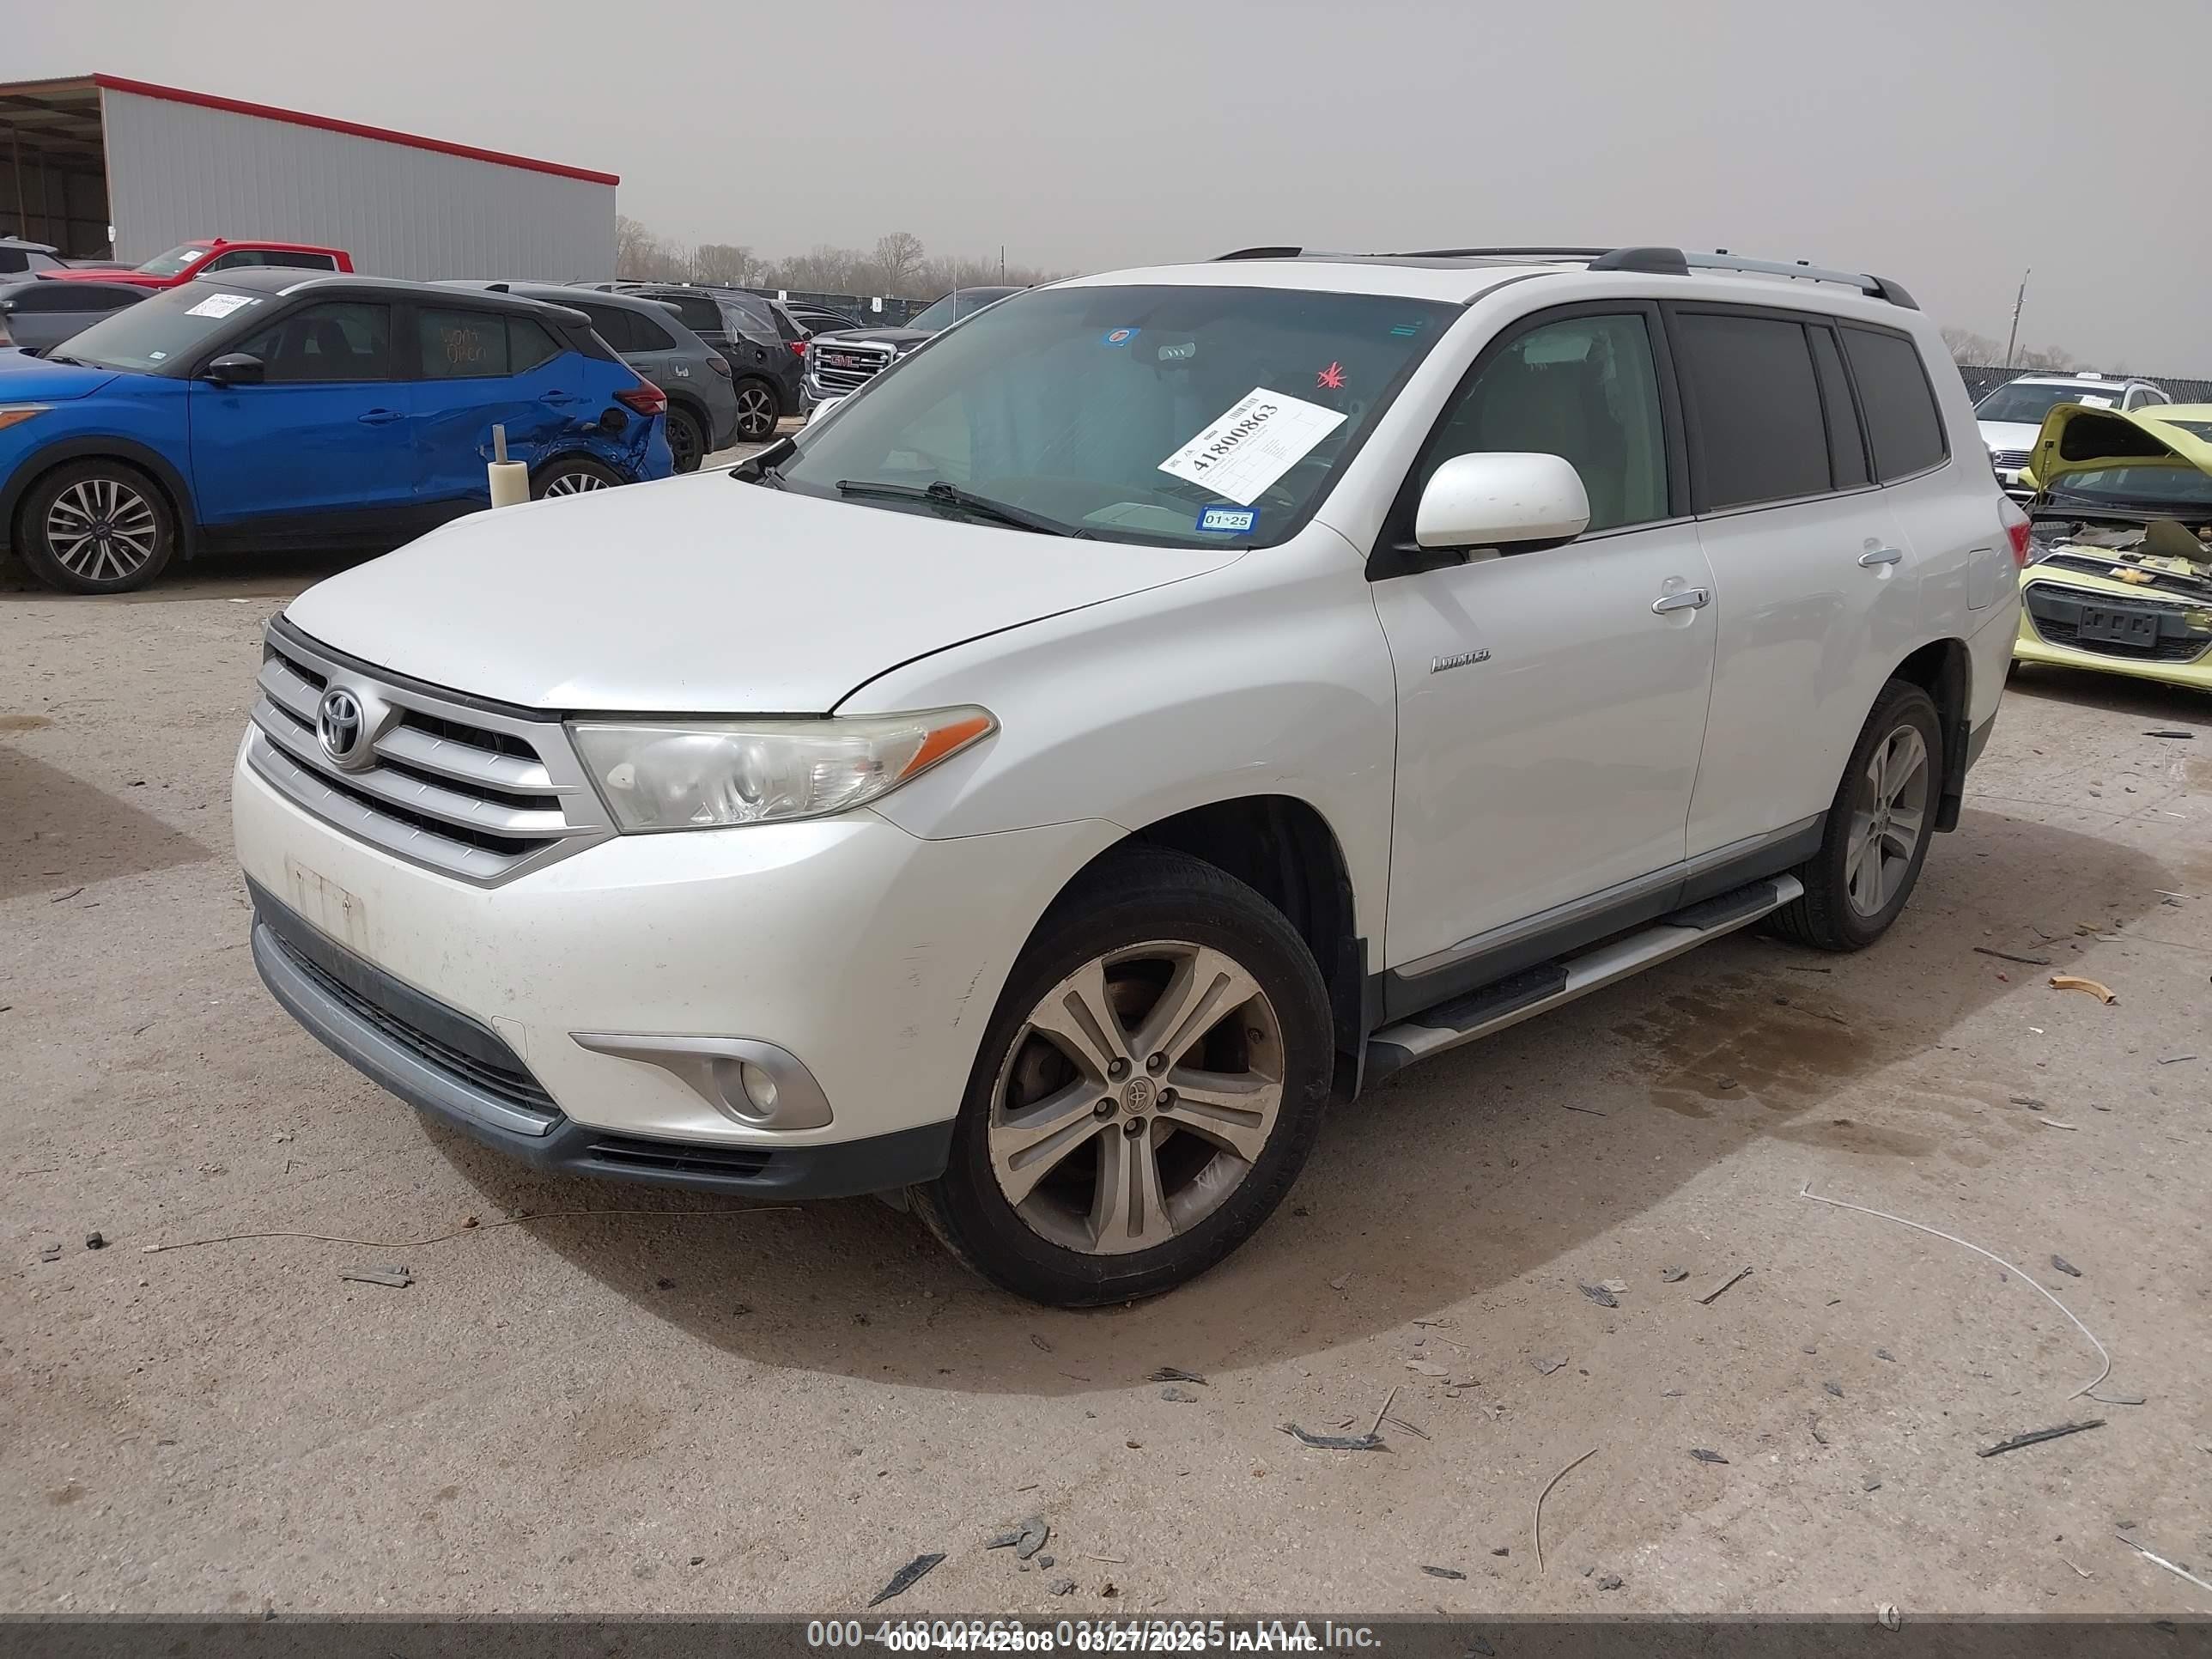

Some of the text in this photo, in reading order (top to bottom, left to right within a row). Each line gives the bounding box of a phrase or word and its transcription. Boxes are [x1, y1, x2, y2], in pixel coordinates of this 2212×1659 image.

[830, 354, 860, 368] GMC
[1193, 404, 1279, 471] 41800863
[1205, 515, 1249, 526] 01 25
